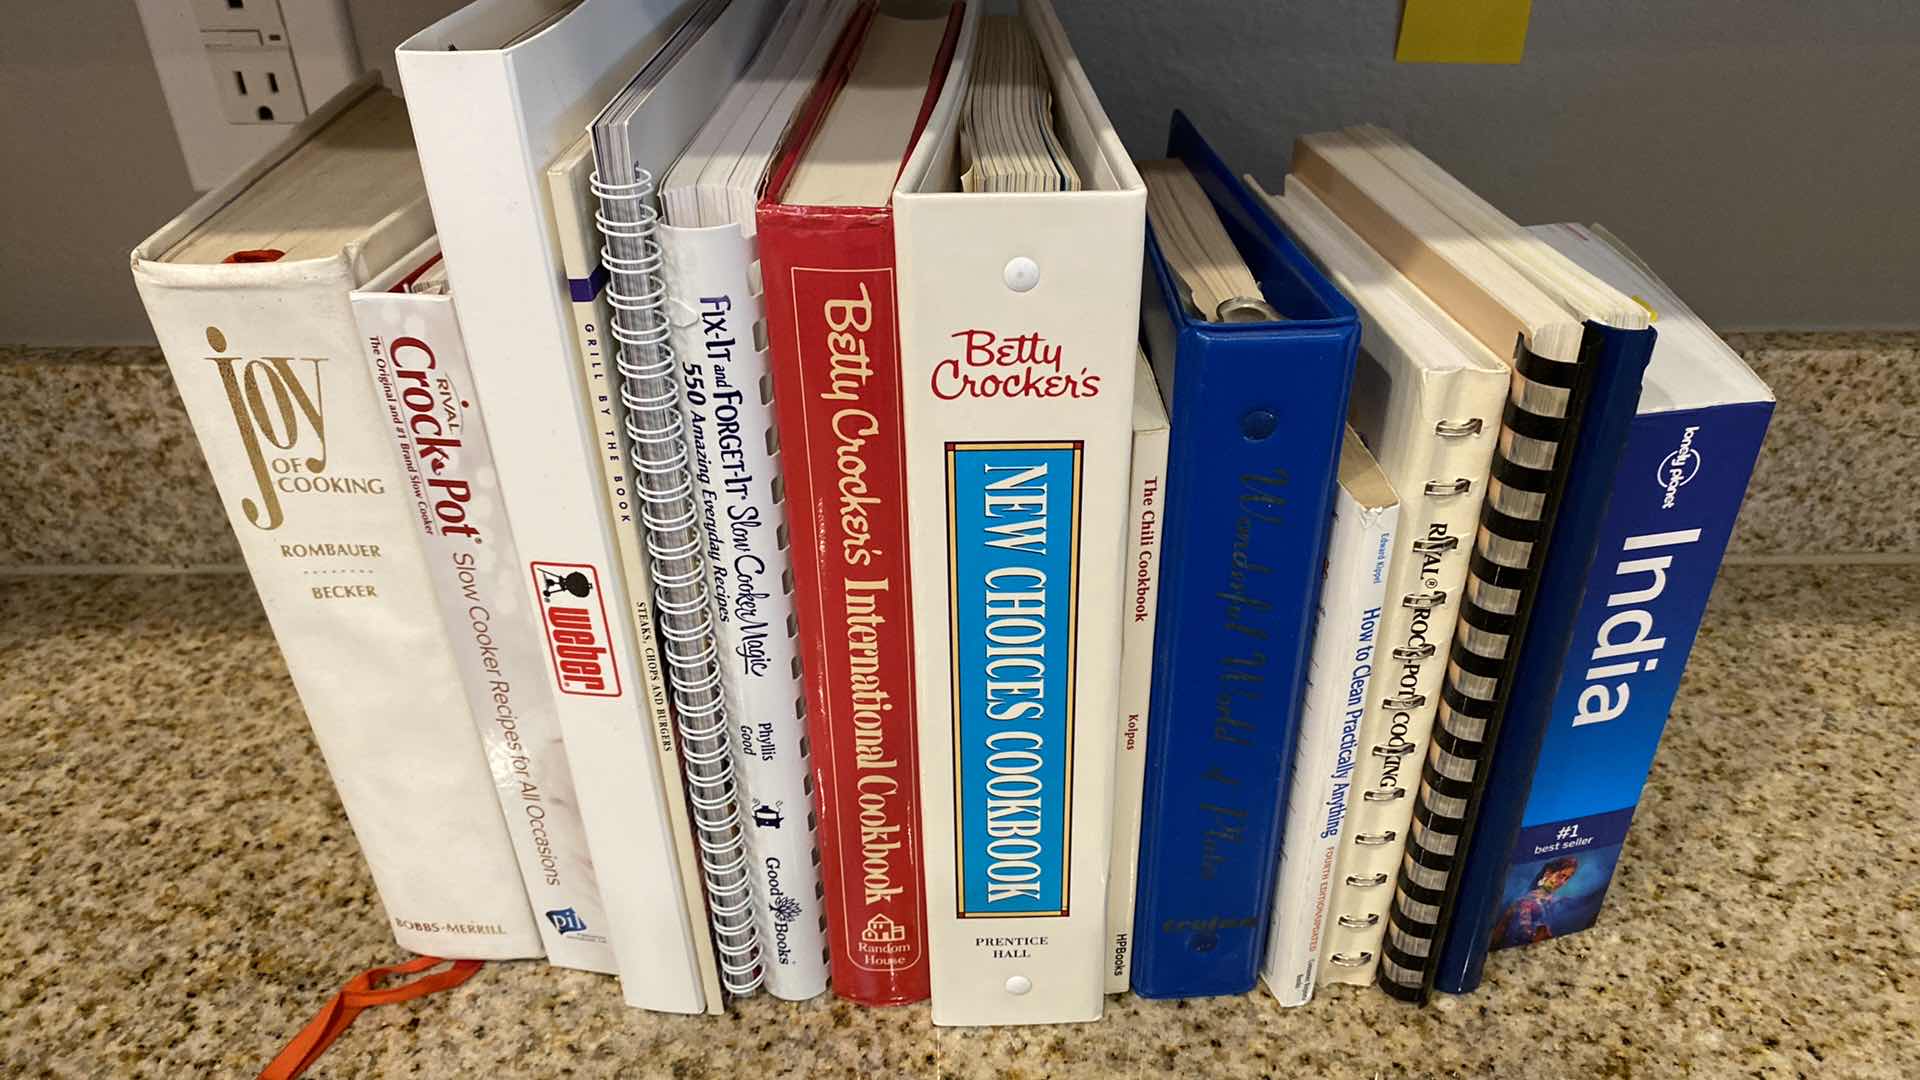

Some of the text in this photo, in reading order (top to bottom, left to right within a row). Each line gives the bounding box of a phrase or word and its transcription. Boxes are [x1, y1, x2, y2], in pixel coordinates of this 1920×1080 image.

[952, 329, 1063, 373] Betty
[714, 364, 733, 388] and
[931, 359, 1101, 400] Crocker's
[436, 378, 460, 433] RIVAL
[585, 323, 631, 522] GRILL BY THE BOOK
[369, 336, 380, 355] The
[376, 358, 393, 402] Original
[389, 403, 402, 424] and
[400, 443, 413, 473] Brand
[410, 476, 424, 498] Slow
[418, 501, 433, 536] Cooker
[272, 458, 303, 474] OF
[278, 477, 385, 494] COOKING
[1662, 426, 1700, 509] lonely planet
[683, 361, 731, 622] 550 Amazing Everyday Recipes
[727, 505, 762, 552] Slow
[281, 544, 381, 558] ROMBAUER
[1135, 476, 1158, 623] The Chili Cookbook
[312, 585, 378, 600] BECKER
[734, 554, 770, 623] Cooker
[820, 281, 904, 906] Betty Crocker's International Cookbook
[1572, 528, 1702, 728] India
[645, 648, 658, 681] CHOPS
[735, 621, 772, 677] Magic
[652, 685, 663, 706] AND
[984, 462, 1048, 903] NEW CHOICES COOKBOOK
[453, 552, 560, 886] Slow Cooker Recipes for All Occasions
[657, 709, 673, 752] BURGERS
[1126, 714, 1138, 751] Kolpas
[1321, 607, 1381, 839] How to Clean Practically Anything
[740, 724, 757, 756] Good
[758, 722, 776, 761] Phyllis
[1534, 836, 1594, 854] best seller
[1556, 824, 1579, 840] #1
[766, 857, 783, 896] Good
[774, 921, 792, 965] Books
[858, 942, 911, 953] Random
[865, 955, 905, 965] House
[975, 937, 1049, 946] PRENTICE
[993, 949, 1031, 959] HALL
[1114, 934, 1127, 976] HPBooks
